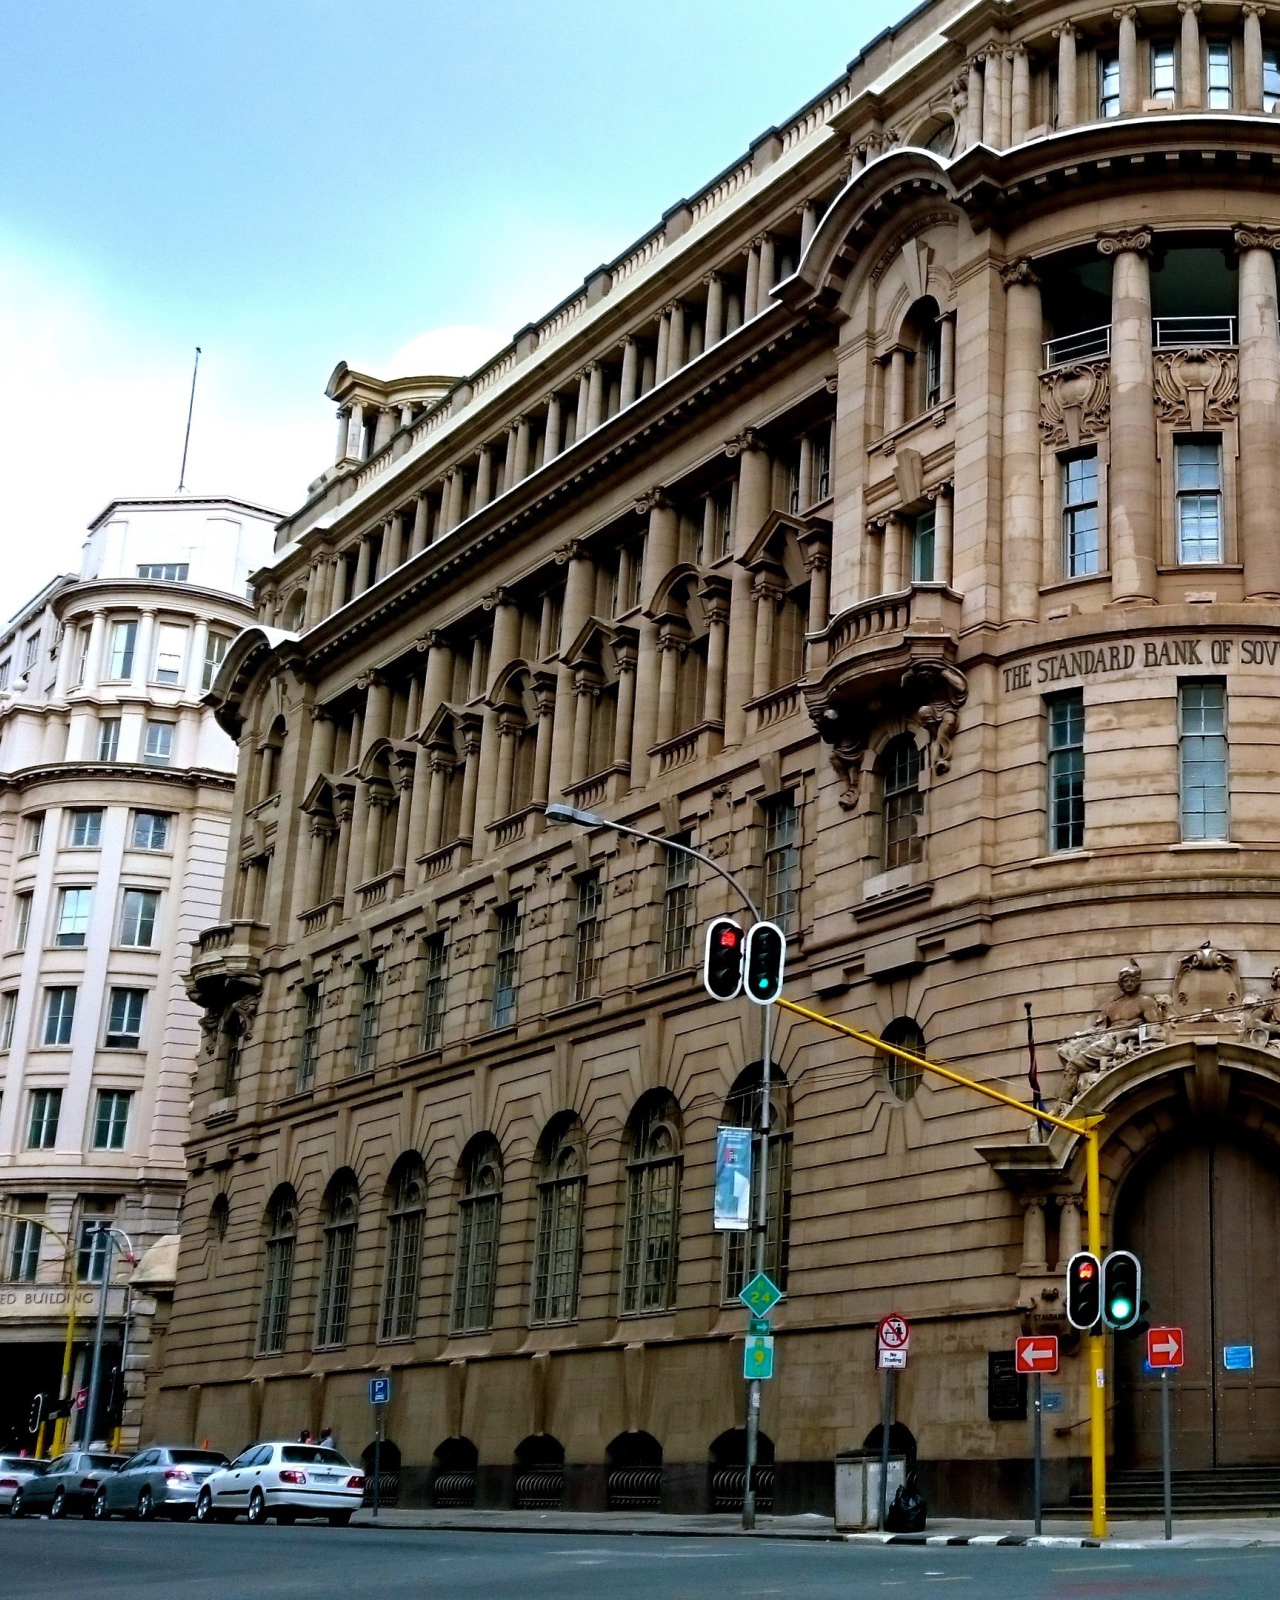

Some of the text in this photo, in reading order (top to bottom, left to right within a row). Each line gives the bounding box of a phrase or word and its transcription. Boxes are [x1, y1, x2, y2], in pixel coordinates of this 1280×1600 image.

[1003, 665, 1032, 692] THE
[1038, 644, 1135, 684] STANDARD
[1144, 640, 1201, 668] BANK
[1211, 639, 1233, 665] OF
[25, 1292, 94, 1305] BUILDING
[750, 1291, 771, 1304] 24
[755, 1350, 765, 1363] 9
[375, 1380, 384, 1392] P
